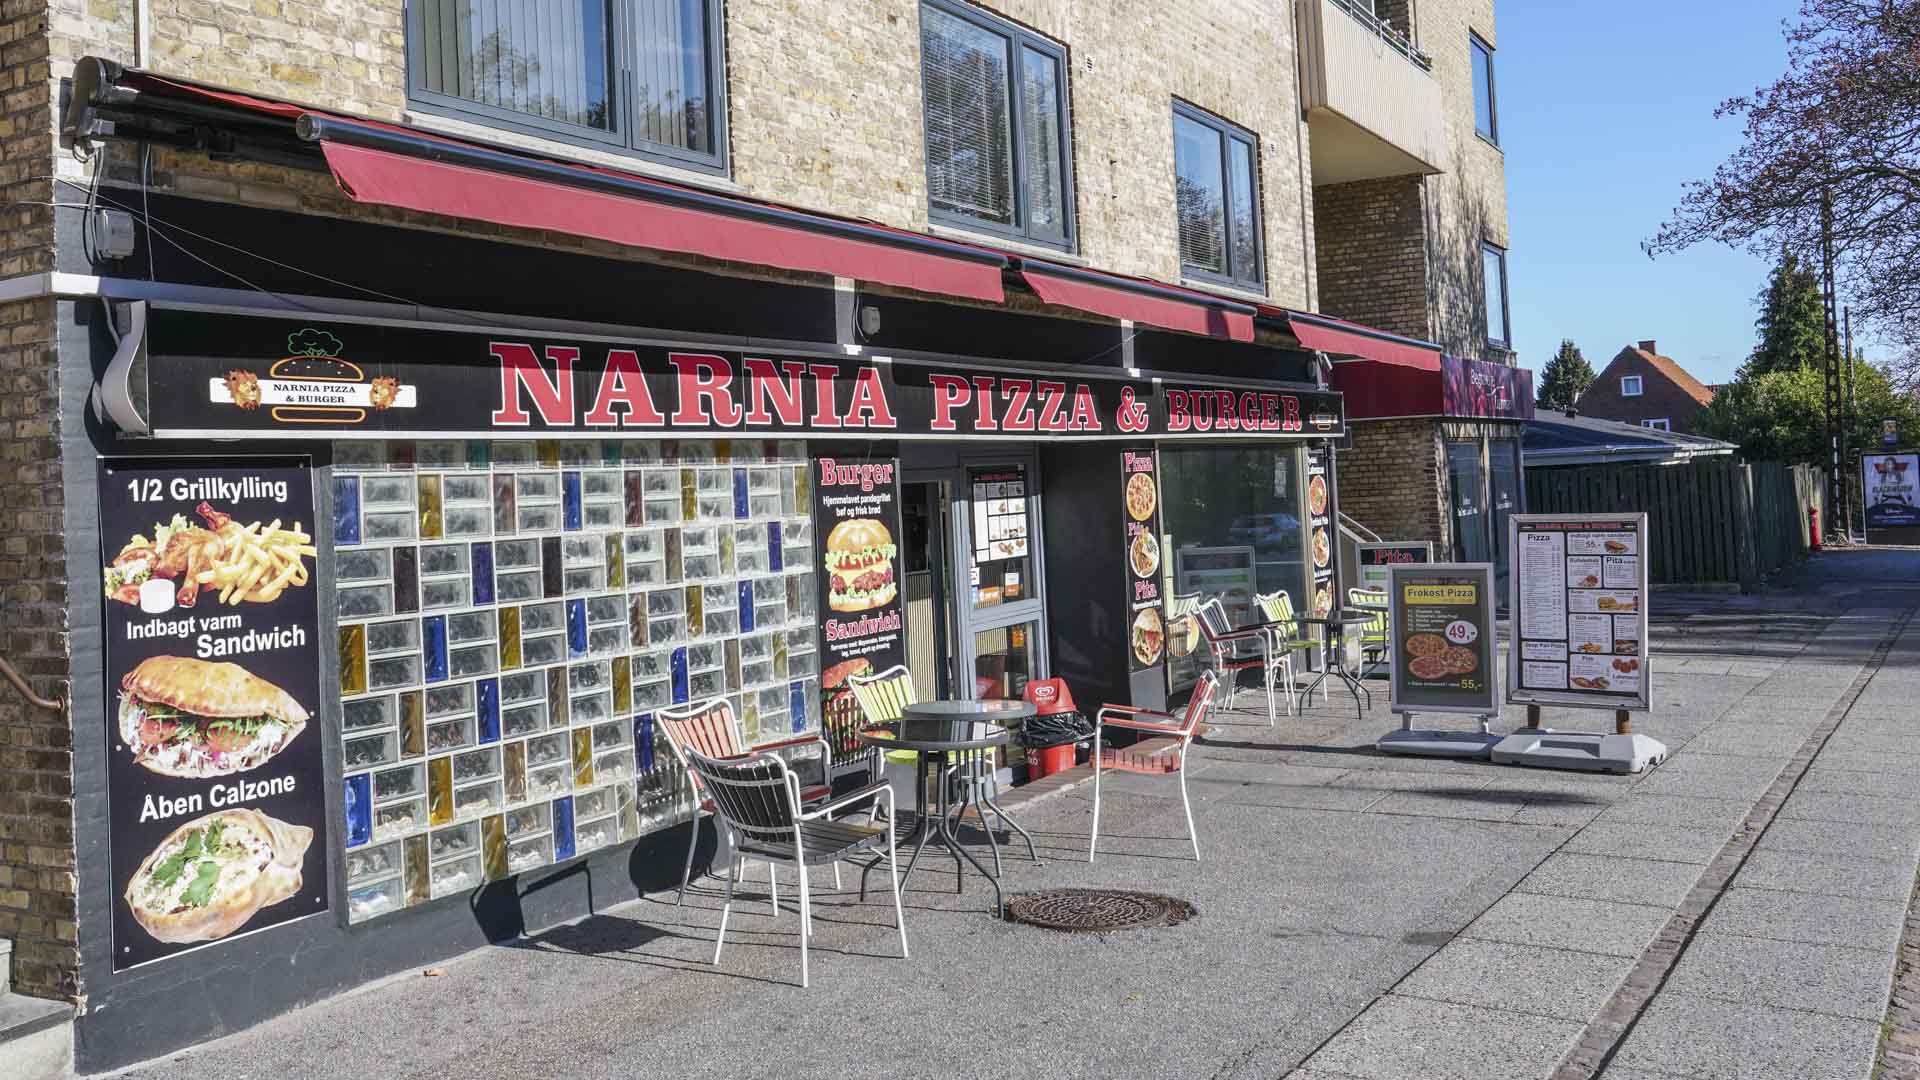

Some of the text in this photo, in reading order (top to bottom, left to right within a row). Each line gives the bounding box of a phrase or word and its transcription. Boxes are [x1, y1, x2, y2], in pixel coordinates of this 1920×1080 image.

[273, 383, 356, 393] NARNIA PIZZA
[298, 395, 345, 403] BURGER
[489, 341, 1303, 431] NARNIA PIZZA & BURGER
[820, 458, 894, 492] Burger
[127, 476, 288, 504] 1/2 Grillkylling
[847, 507, 855, 517] og
[1606, 556, 1623, 564] Pita
[1407, 588, 1473, 597] Frokost Pizza
[127, 614, 242, 640] Indbagt varm
[825, 609, 901, 641] Sandwich
[196, 624, 306, 658] Sandwich
[139, 775, 297, 823] Åben Calzone
